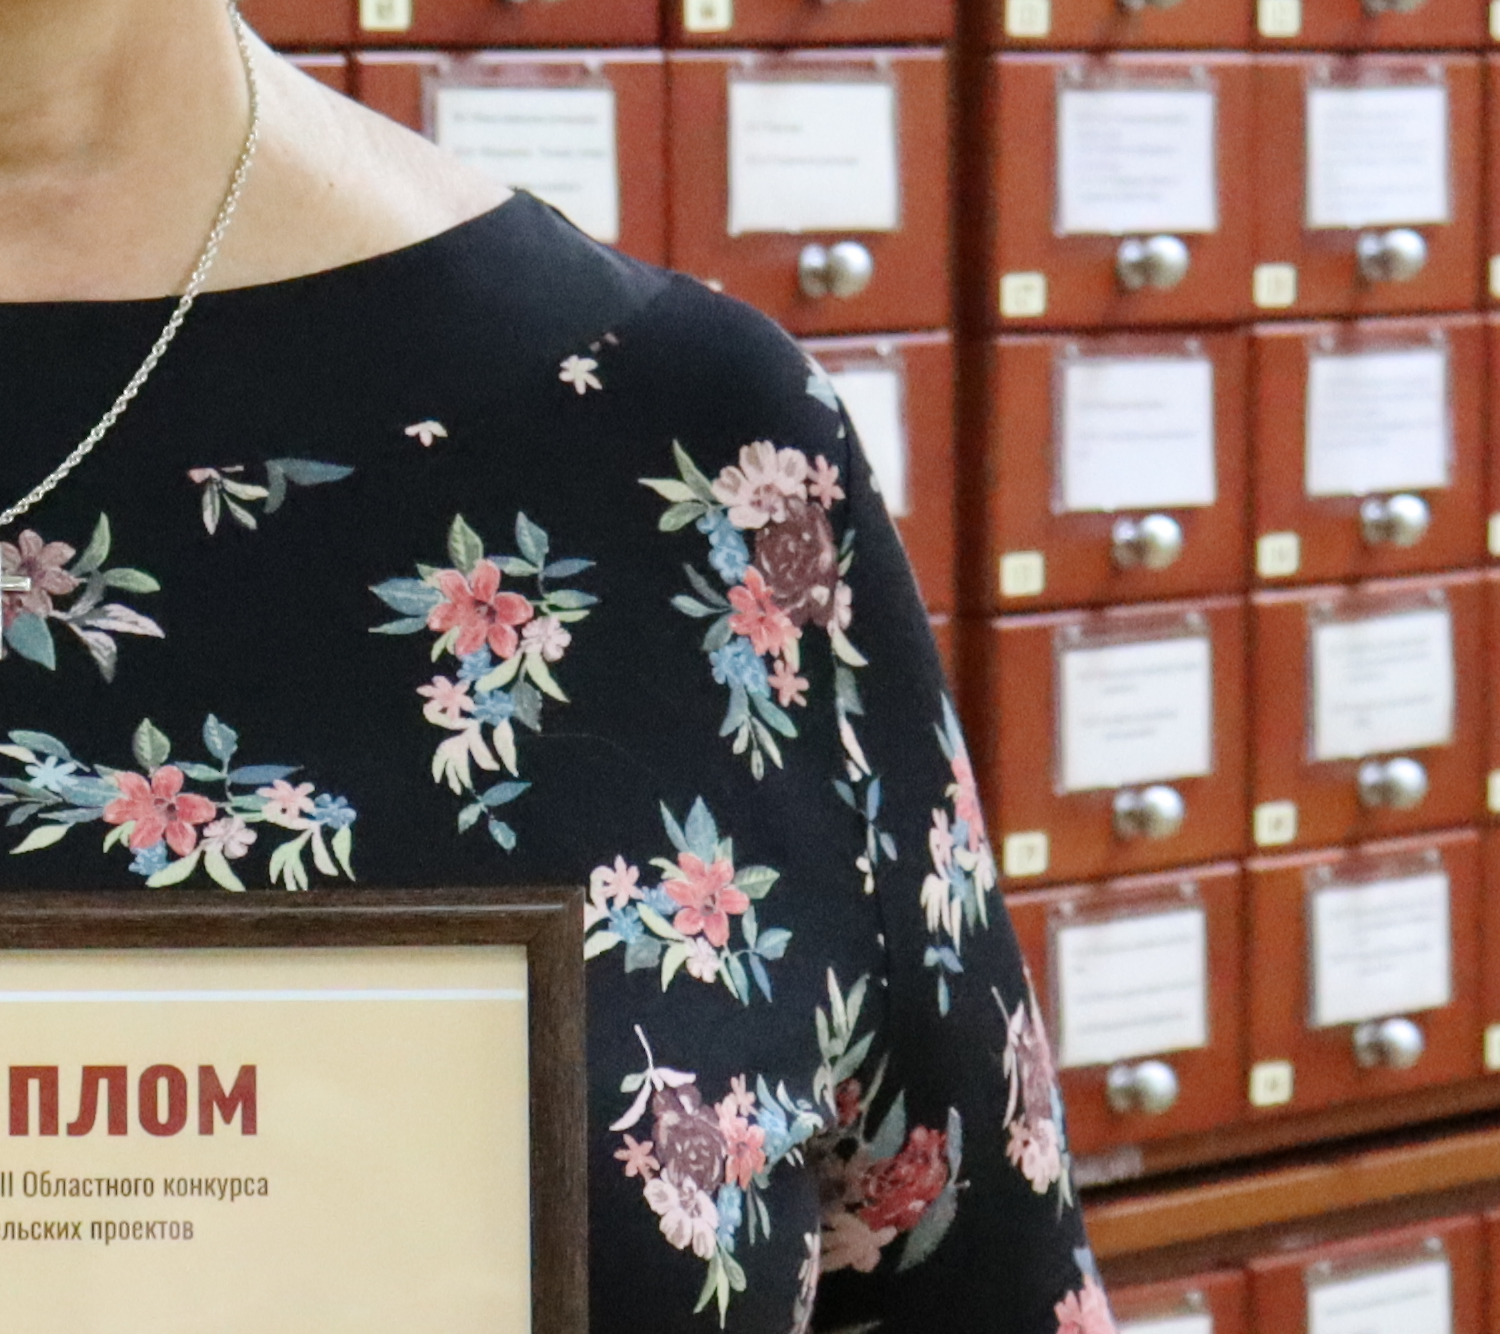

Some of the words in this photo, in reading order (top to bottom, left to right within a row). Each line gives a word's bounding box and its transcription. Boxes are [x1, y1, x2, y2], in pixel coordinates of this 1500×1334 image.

[22, 1170, 155, 1198] Областного
[163, 1176, 269, 1203] конкурса
[89, 1220, 195, 1247] проектов
